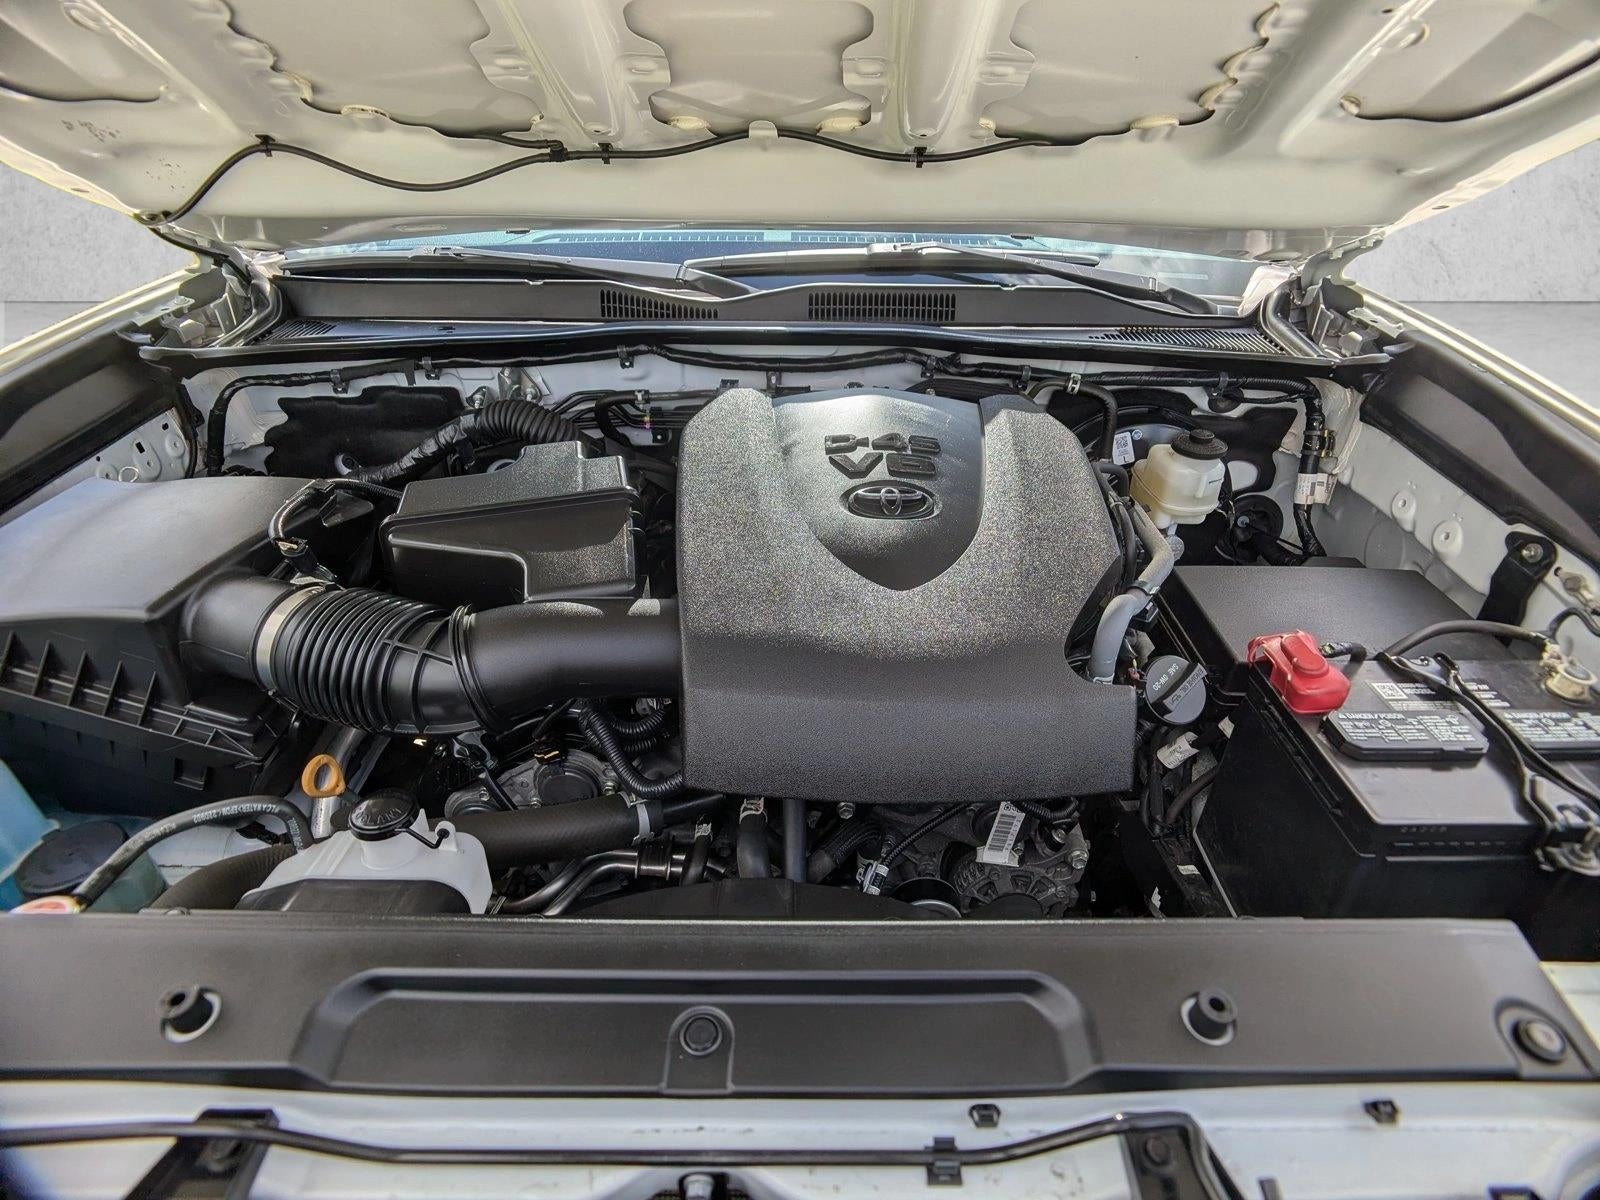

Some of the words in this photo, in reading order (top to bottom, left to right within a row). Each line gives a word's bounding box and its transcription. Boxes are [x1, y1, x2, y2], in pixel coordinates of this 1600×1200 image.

[825, 432, 942, 456] D-4S
[829, 452, 939, 480] V6
[1168, 663, 1179, 676] SAE
[1152, 674, 1169, 691] 0W-20
